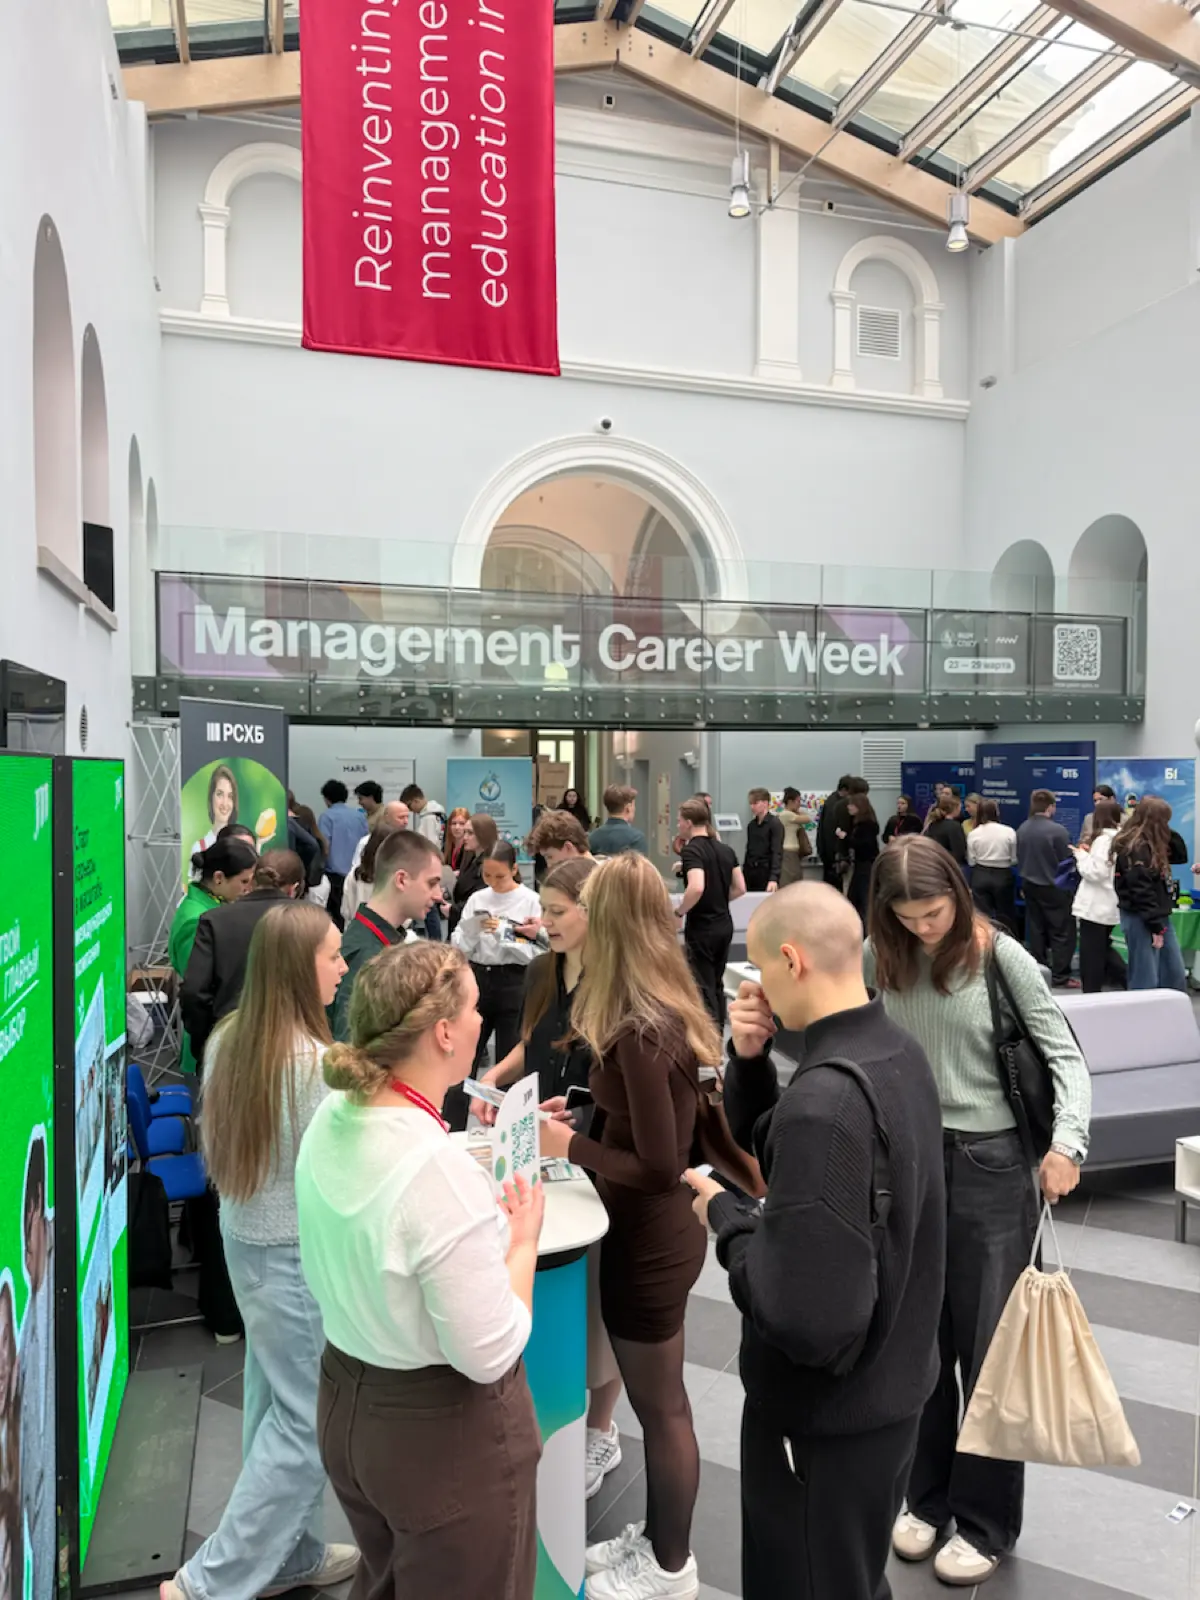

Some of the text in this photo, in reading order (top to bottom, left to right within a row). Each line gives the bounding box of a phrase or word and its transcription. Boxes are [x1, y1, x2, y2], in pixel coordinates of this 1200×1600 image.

[419, 0, 460, 299] manageme
[471, 50, 508, 307] education
[194, 604, 904, 677] Management Career Week
[223, 723, 265, 744] РСХБ
[1062, 768, 1079, 779] ВТБ
